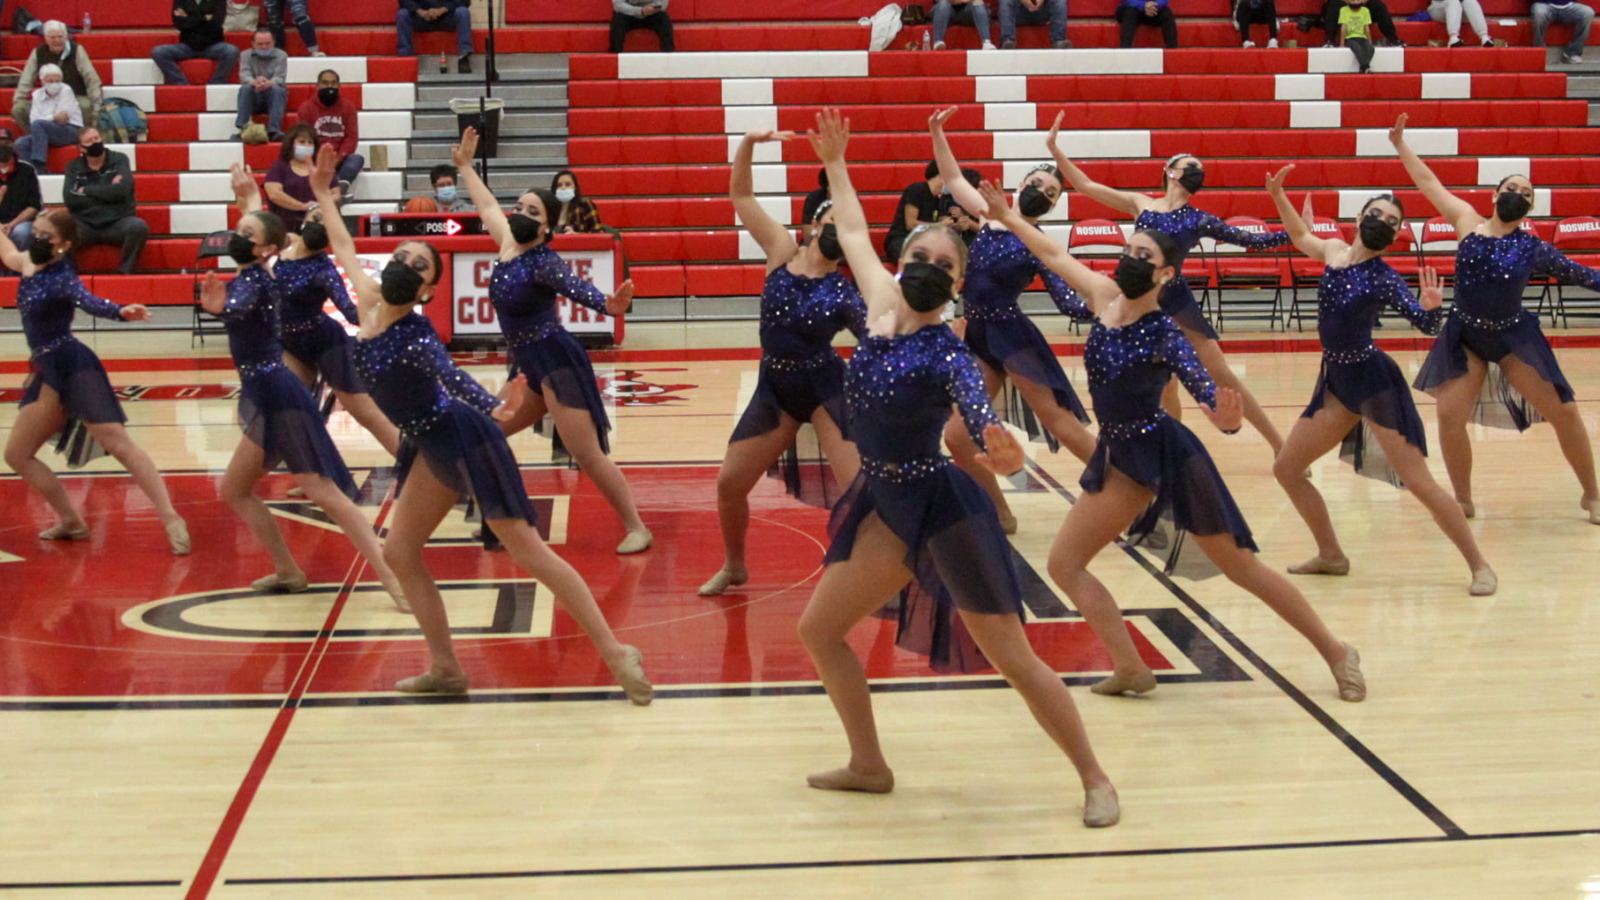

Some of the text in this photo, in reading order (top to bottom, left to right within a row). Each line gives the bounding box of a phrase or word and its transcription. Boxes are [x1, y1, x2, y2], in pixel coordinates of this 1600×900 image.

[426, 222, 448, 233] POSS
[1076, 225, 1119, 235] ROSWELL
[1311, 223, 1337, 232] WELL
[1429, 223, 1455, 233] ROSW
[1559, 221, 1600, 233] ROSWELL
